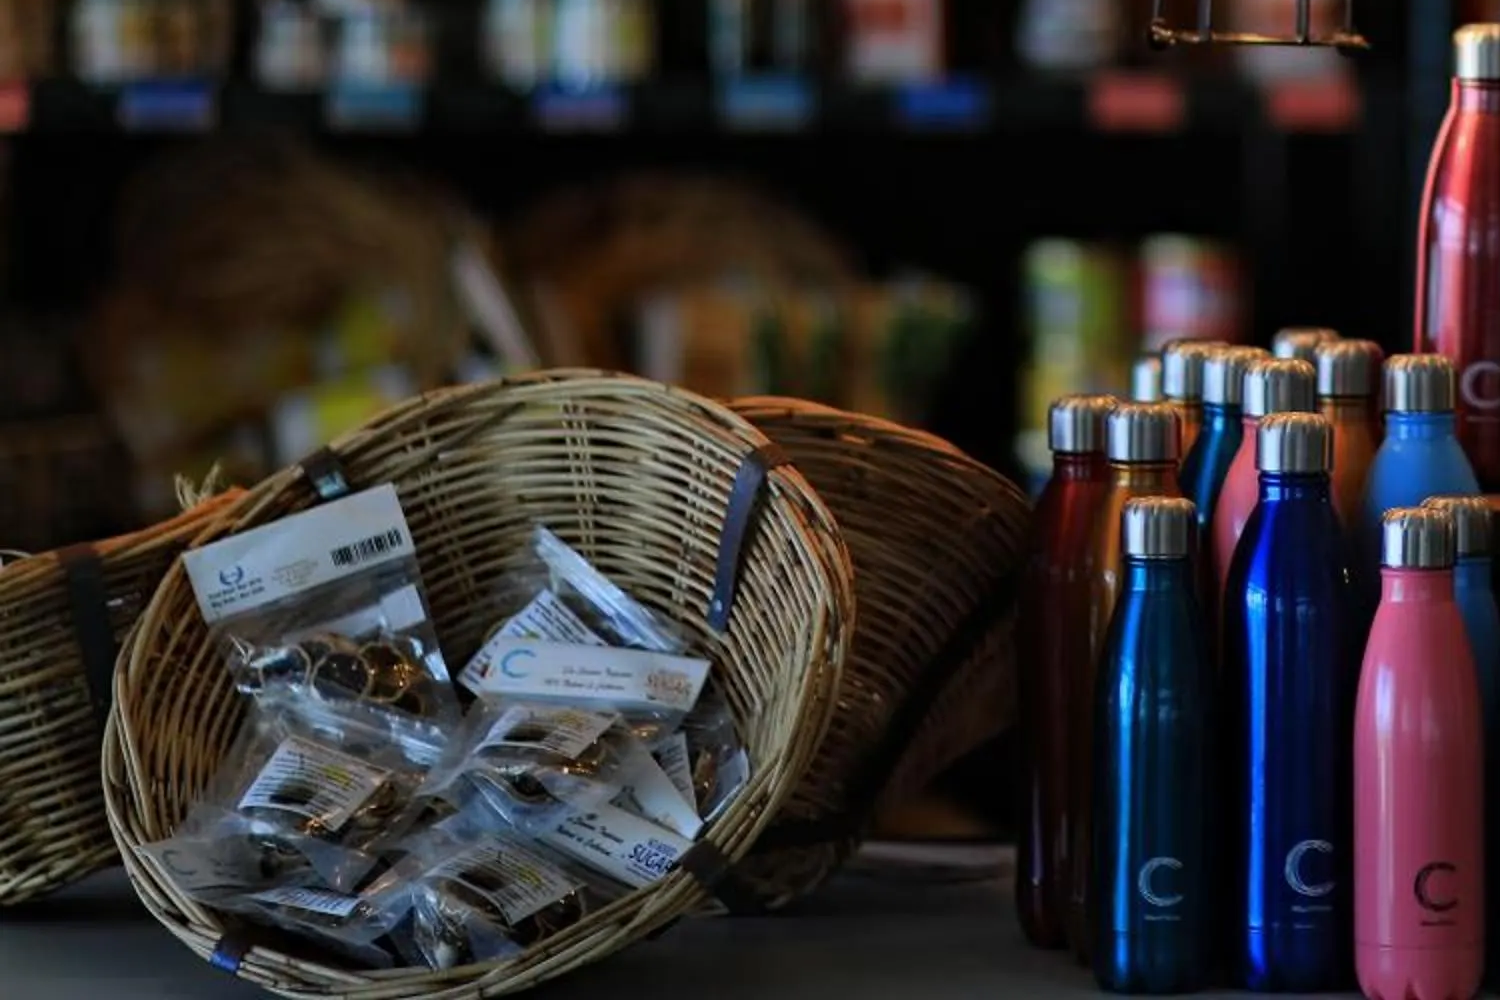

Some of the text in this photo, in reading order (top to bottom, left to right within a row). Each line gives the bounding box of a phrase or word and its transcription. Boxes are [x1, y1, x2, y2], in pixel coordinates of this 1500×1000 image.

[1138, 856, 1184, 907] C
[1285, 839, 1337, 897] C
[1414, 861, 1457, 912] C
